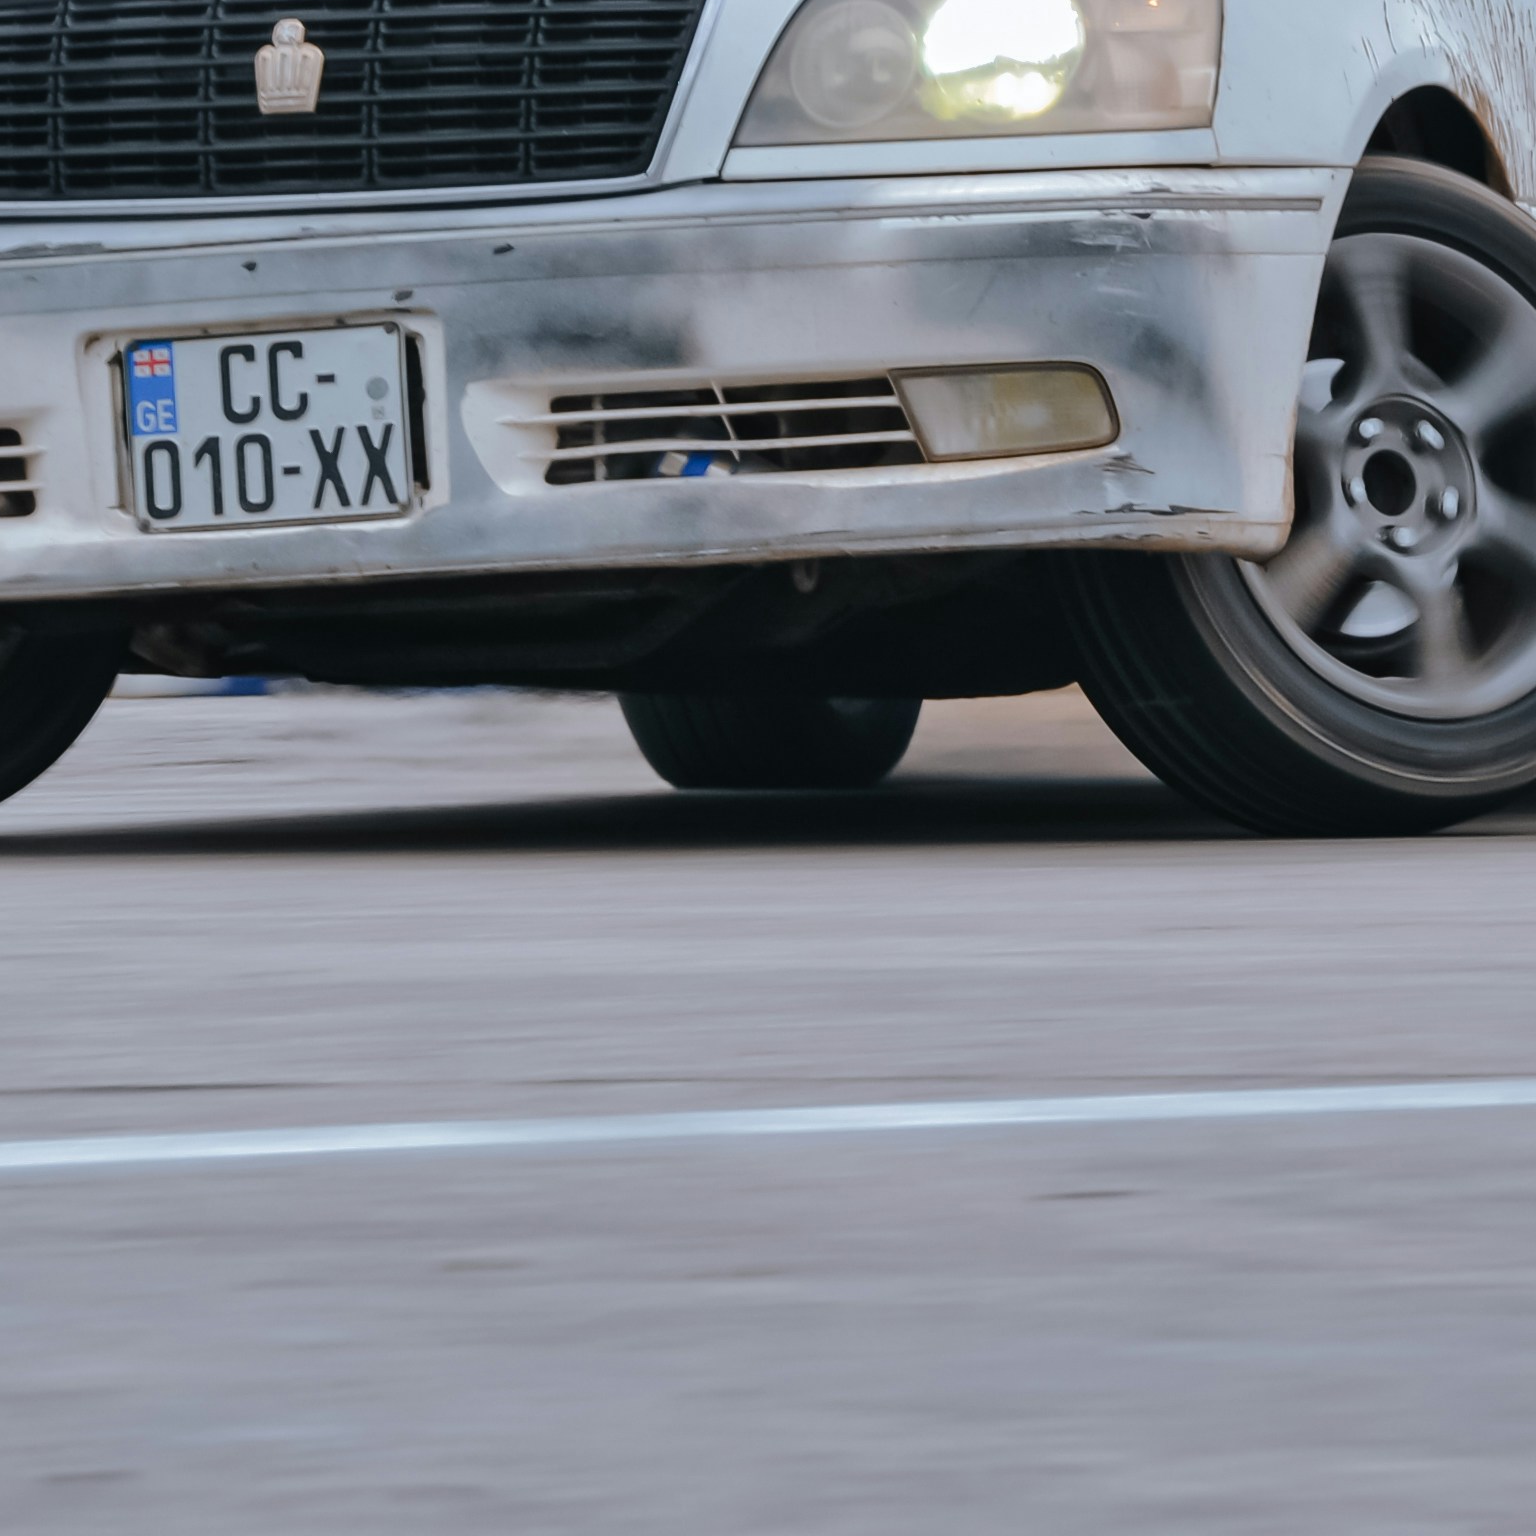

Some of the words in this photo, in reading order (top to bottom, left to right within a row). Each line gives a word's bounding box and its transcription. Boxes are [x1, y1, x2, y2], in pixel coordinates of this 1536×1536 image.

[136, 399, 176, 433] GE
[219, 340, 336, 424] CC-
[143, 423, 399, 519] 010-XX
